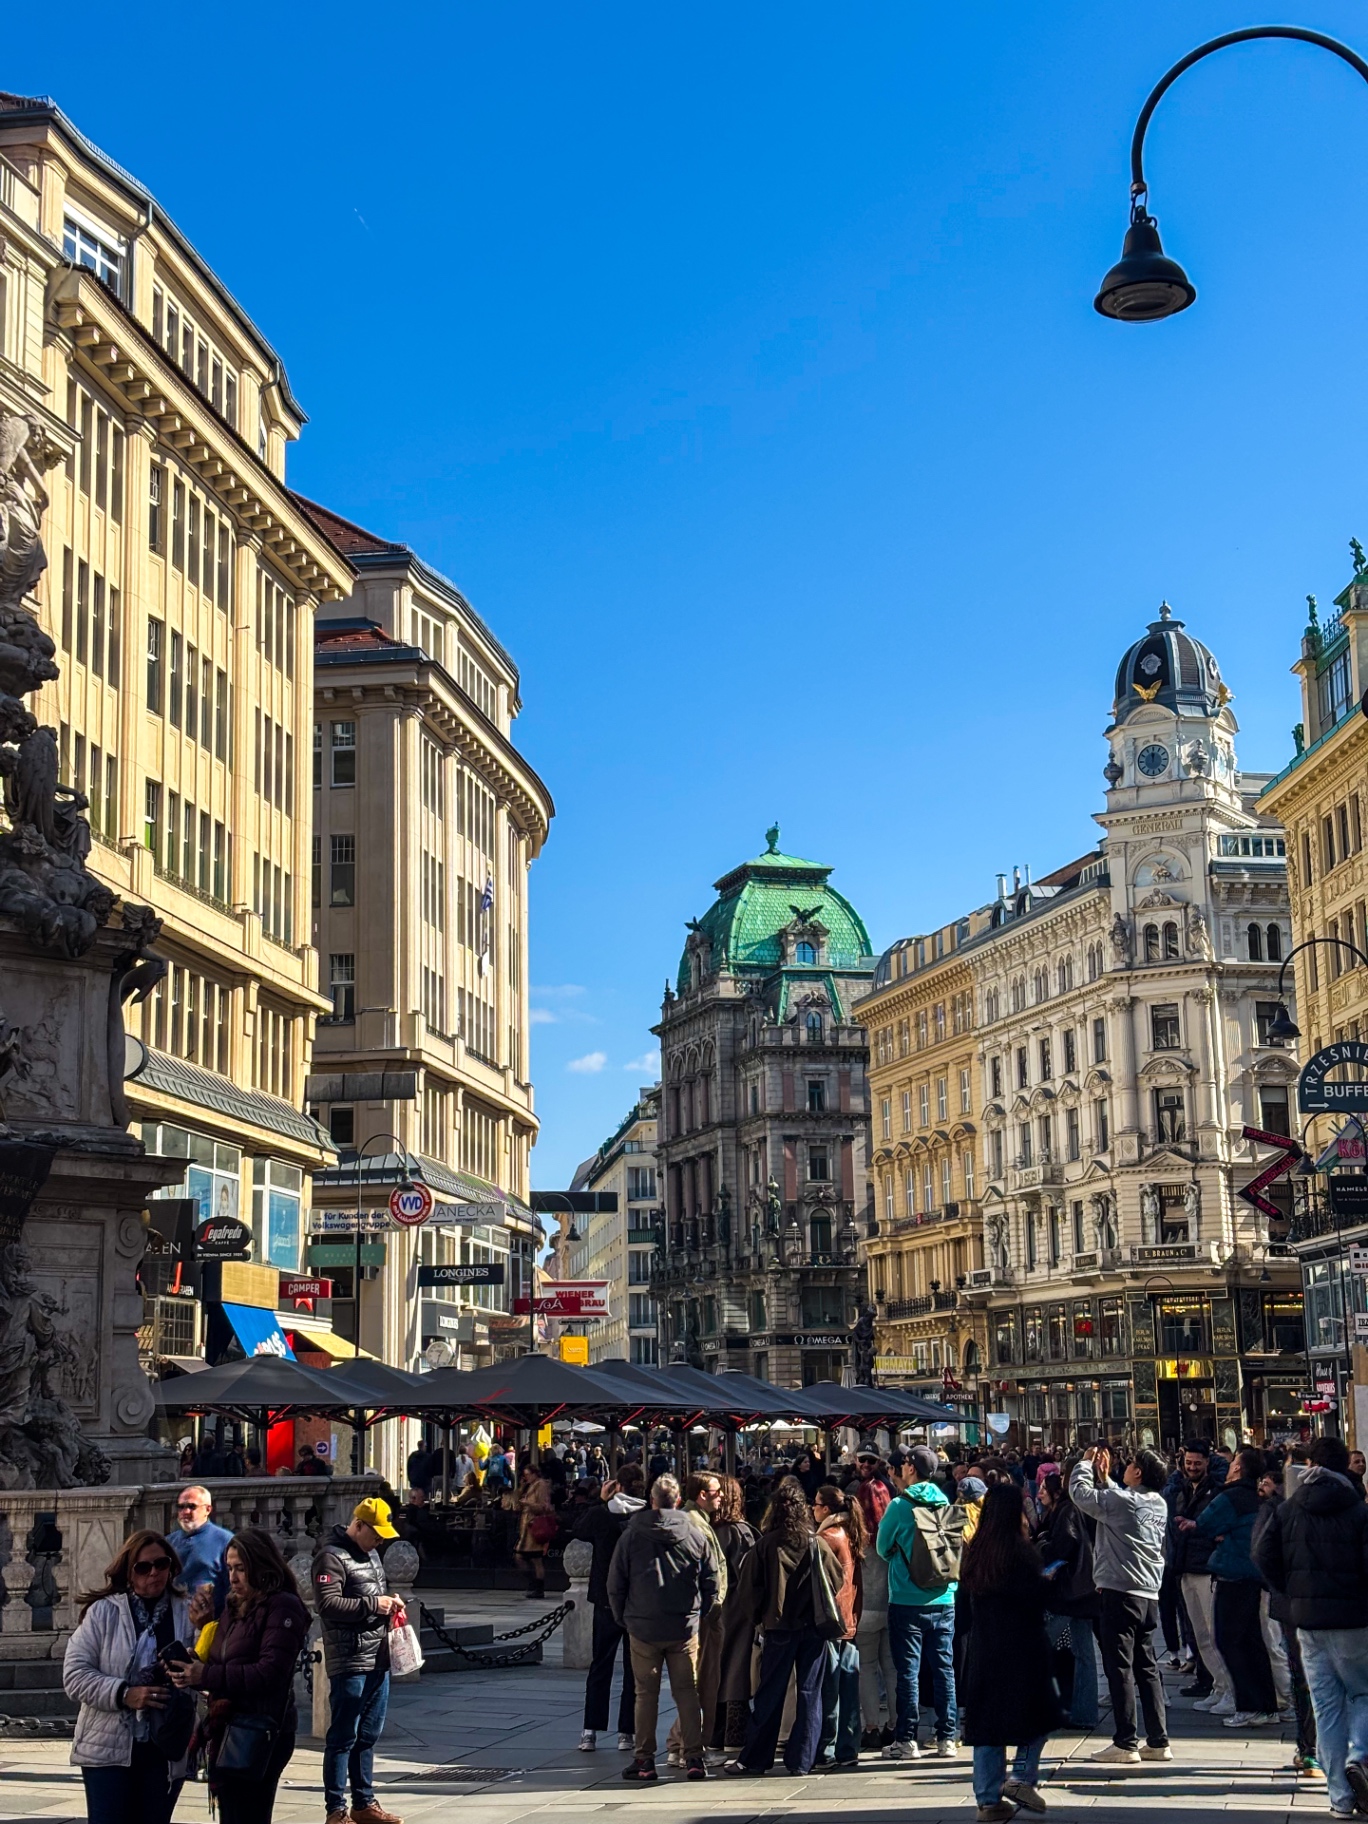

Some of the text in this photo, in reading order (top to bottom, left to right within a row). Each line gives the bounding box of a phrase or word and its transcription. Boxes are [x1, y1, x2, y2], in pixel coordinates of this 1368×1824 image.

[1132, 819, 1183, 835] GENERALI
[1248, 1156, 1297, 1196] FLEDERMAUS
[324, 1211, 336, 1220] für
[338, 1211, 369, 1220] Kunden
[371, 1210, 385, 1219] der
[430, 1204, 496, 1218] JANECKA
[200, 1224, 243, 1242] Segafredo
[1152, 1249, 1174, 1258] BRAUN
[433, 1267, 489, 1278] LONGINES
[288, 1283, 320, 1296] CAMPER
[555, 1290, 595, 1299] WIENER
[806, 1336, 843, 1345] OMEGA
[945, 1393, 974, 1401] APOTHEKE
